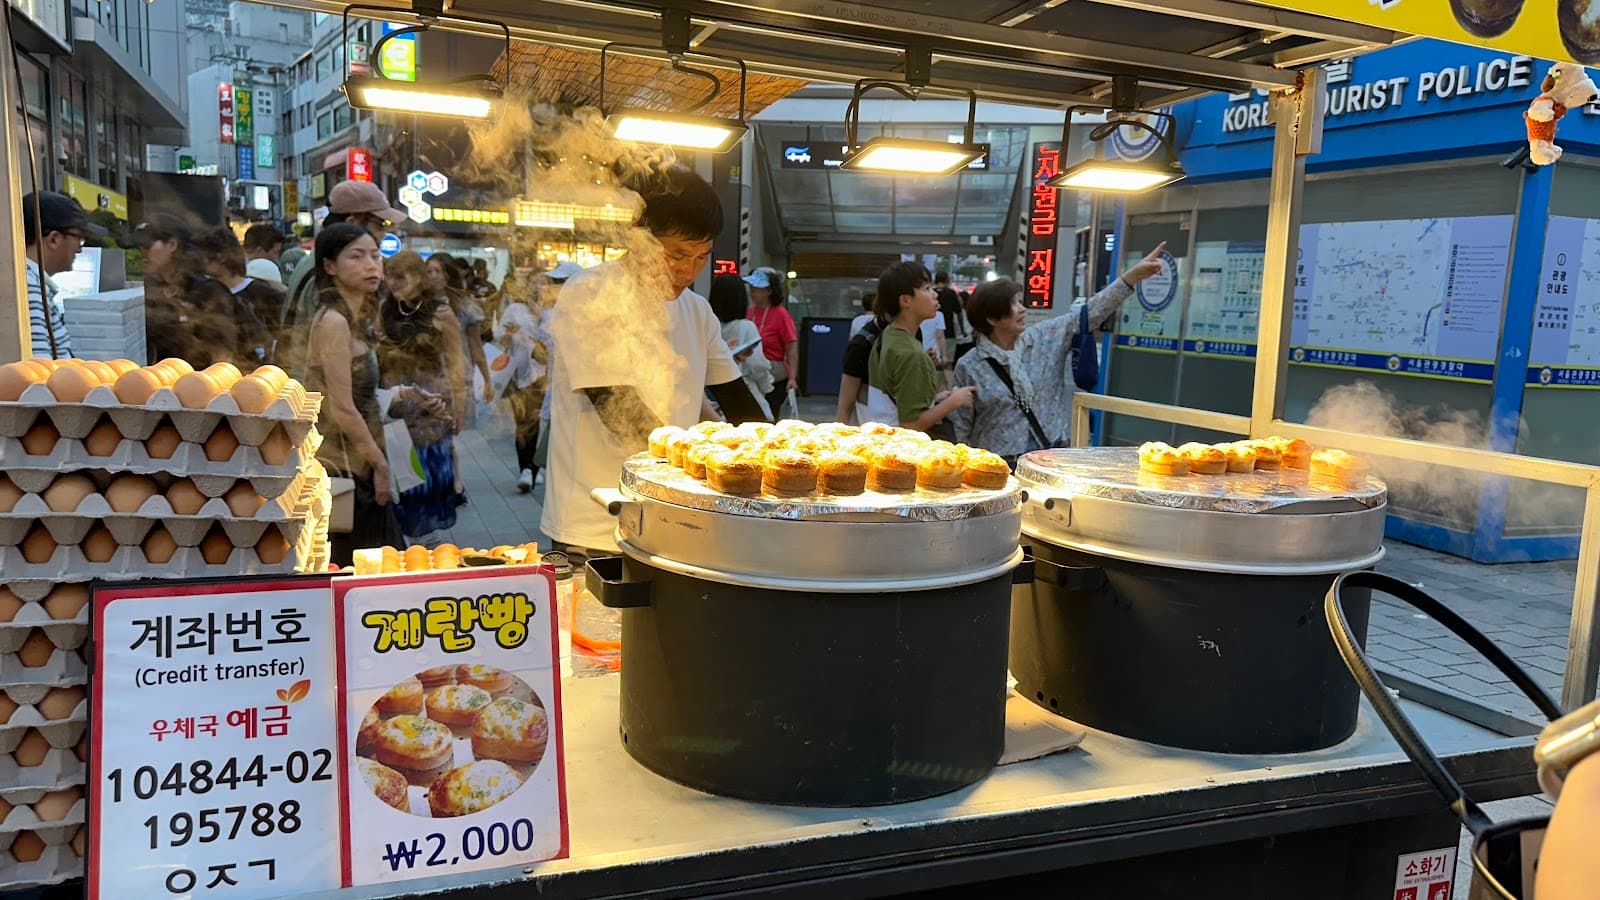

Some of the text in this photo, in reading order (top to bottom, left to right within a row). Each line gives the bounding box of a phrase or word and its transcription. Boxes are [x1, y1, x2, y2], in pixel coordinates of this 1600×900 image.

[1222, 56, 1532, 132] KORE URIST POLICE
[1552, 270, 1567, 281] 관광
[1408, 359, 1463, 371] 서울관광경찰대
[129, 608, 310, 658] 계좌번호
[362, 592, 536, 653] 계란빵
[135, 656, 305, 688] (Credit transfer)
[149, 705, 292, 742] 우체국 예금
[107, 748, 333, 803] 104844-02
[143, 800, 301, 850] 195788
[382, 818, 534, 871] ₩2,000
[1404, 854, 1446, 877] 소화기
